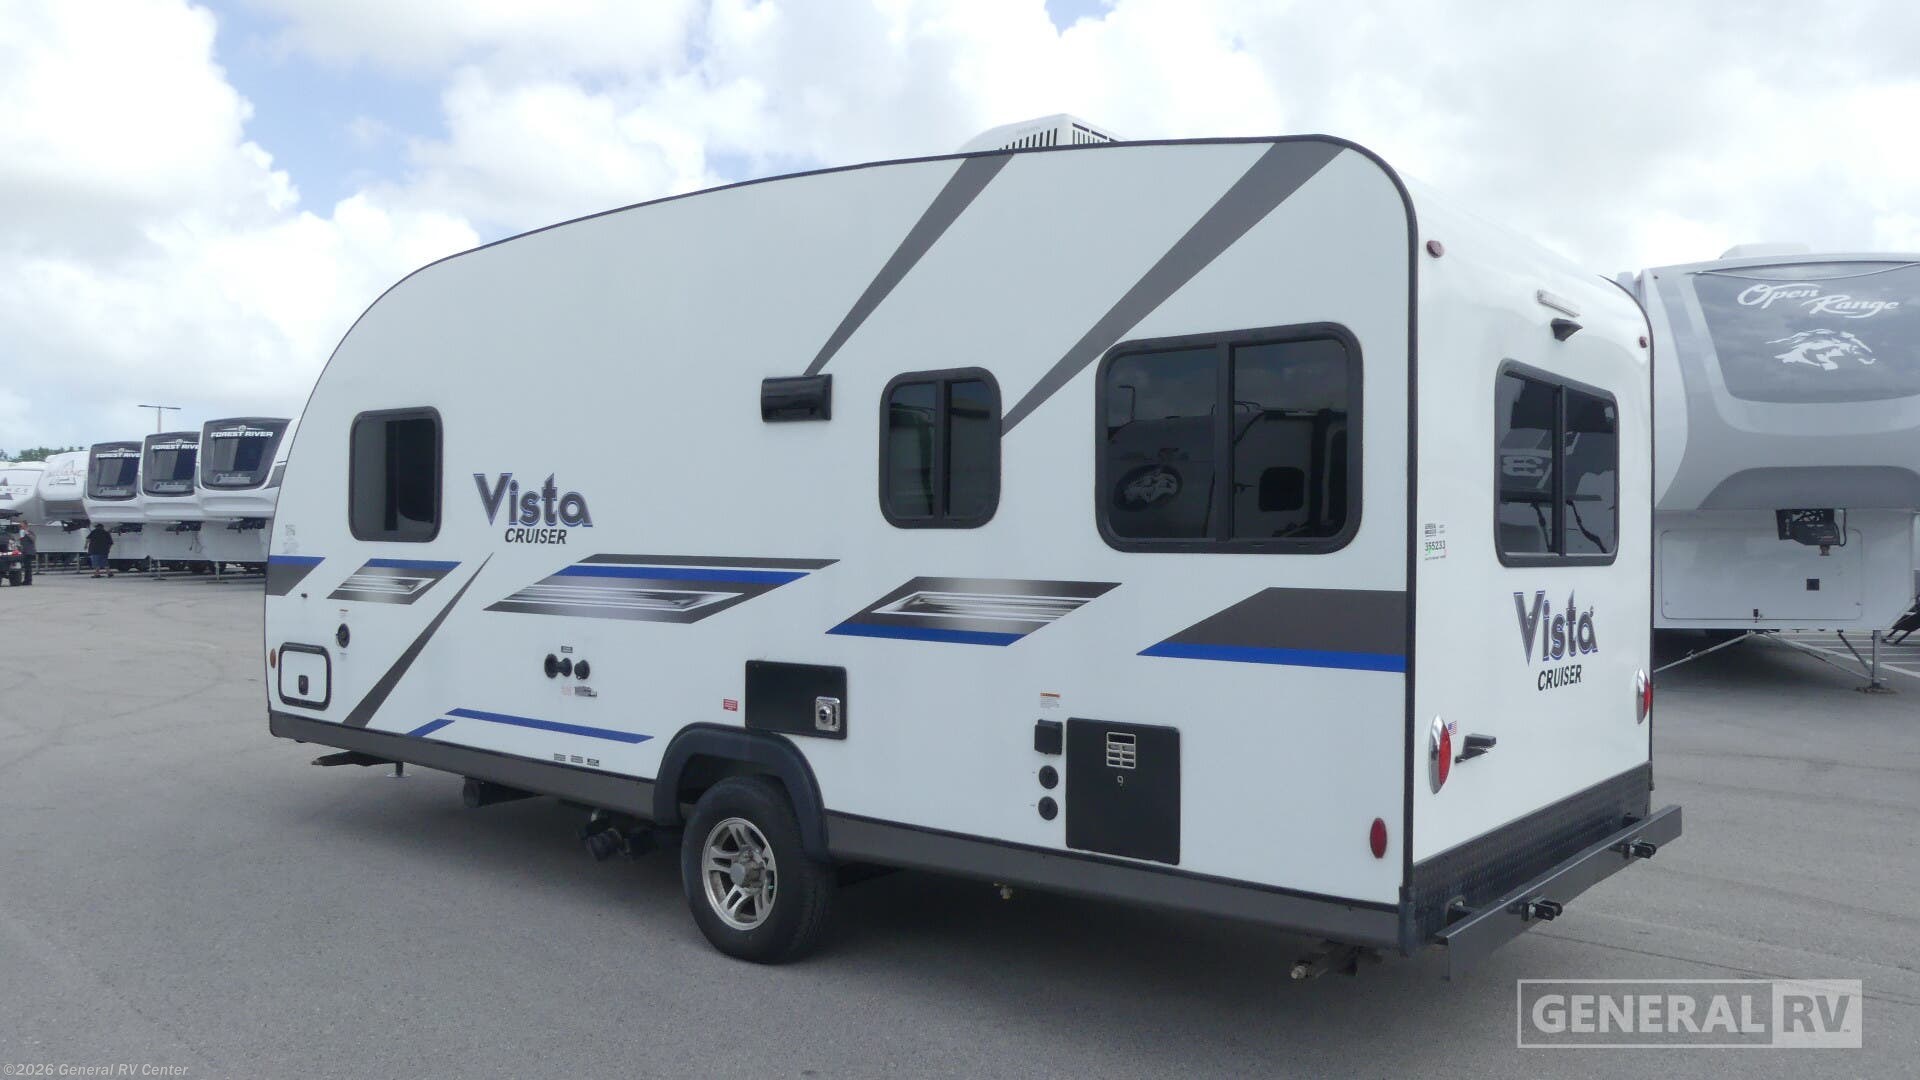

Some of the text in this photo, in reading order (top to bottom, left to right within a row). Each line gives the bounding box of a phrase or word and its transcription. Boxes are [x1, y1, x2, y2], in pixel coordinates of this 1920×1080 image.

[1737, 283, 1899, 319] Open Range
[473, 472, 593, 528] Vista
[505, 528, 567, 544] CRUISER
[1425, 540, 1446, 552] 355233
[1513, 589, 1598, 667] Vista
[1537, 664, 1582, 691] CRUISER
